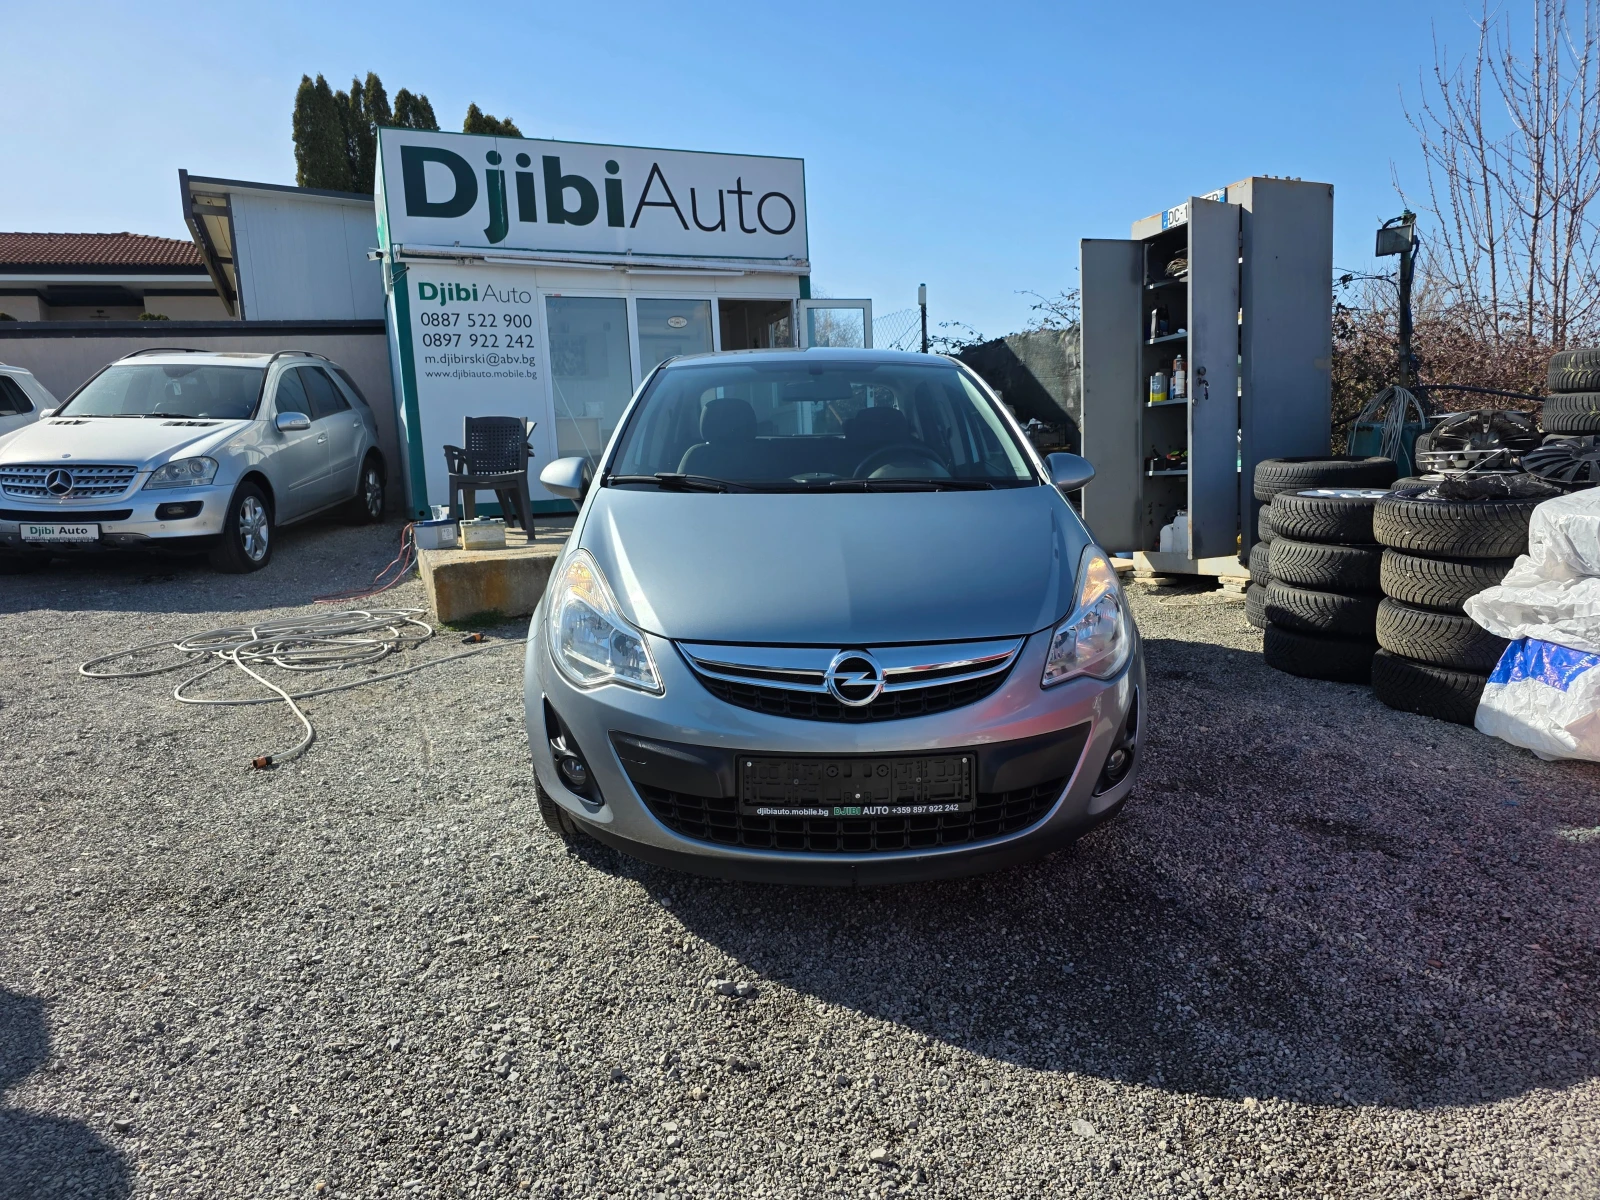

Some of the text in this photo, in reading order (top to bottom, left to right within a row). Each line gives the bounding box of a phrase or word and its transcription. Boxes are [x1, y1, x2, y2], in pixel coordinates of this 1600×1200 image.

[420, 312, 532, 328] 0887 522 900
[422, 333, 535, 348] 0897 922 242
[424, 352, 536, 367] m.djibirski@abv.bg
[425, 369, 538, 380] www.djibiauto.mobile.bg
[29, 526, 88, 537] Djibi Auto
[756, 803, 959, 817] djibiauto.mobile.bg DJIBI AUTO +359 897 922 242
